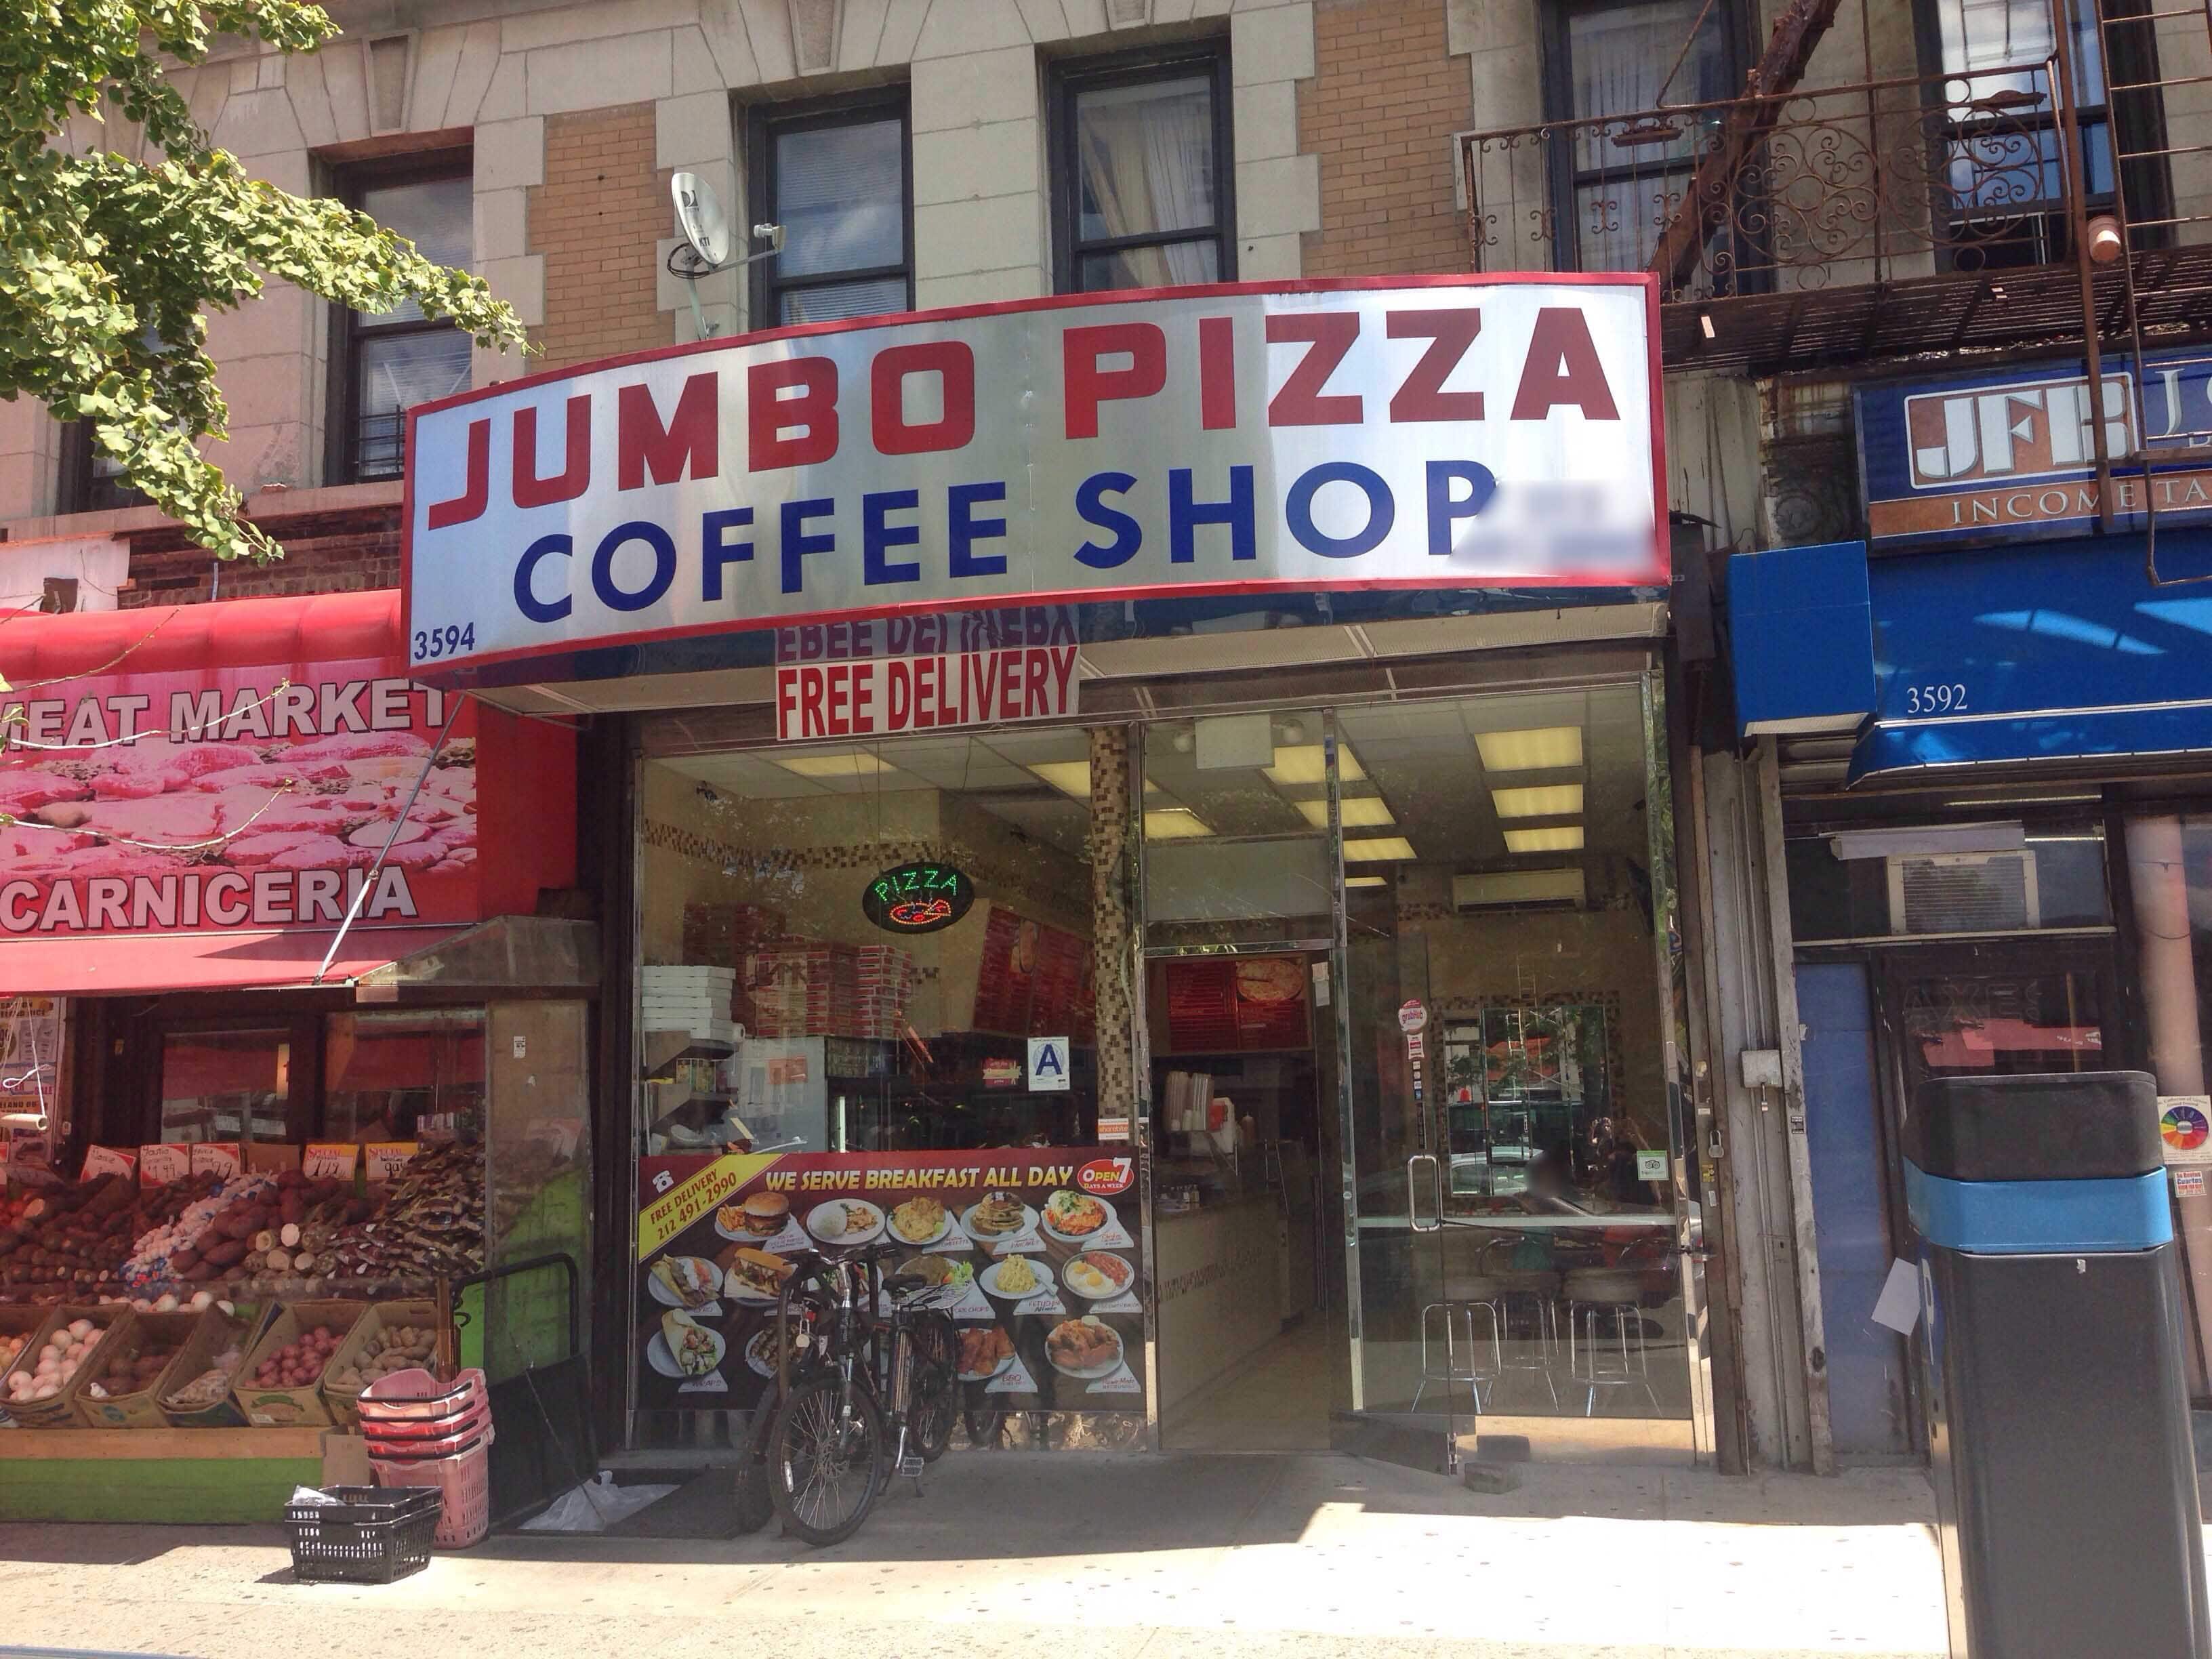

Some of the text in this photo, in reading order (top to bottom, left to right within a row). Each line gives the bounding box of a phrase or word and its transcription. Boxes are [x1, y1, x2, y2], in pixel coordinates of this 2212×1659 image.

[428, 307, 1620, 531] JUMBO PIZZA
[1952, 483, 2136, 525] INCOME
[514, 459, 1496, 623] COFFEE SHOP
[414, 623, 475, 661] 3594
[169, 678, 445, 744] MARKET
[777, 646, 1078, 739] FREE DELIVERY
[1906, 684, 1969, 714] 3592
[1, 865, 419, 933] CARNICERIA
[875, 870, 958, 903] PIZZA
[1036, 1044, 1063, 1076] A
[765, 1165, 1073, 1191] WE SERVE BREAKFAST ALL DAY
[1082, 1157, 1132, 1183] OPEN 7
[650, 1168, 718, 1225] FREE DELIVERY
[657, 1219, 677, 1241] 212
